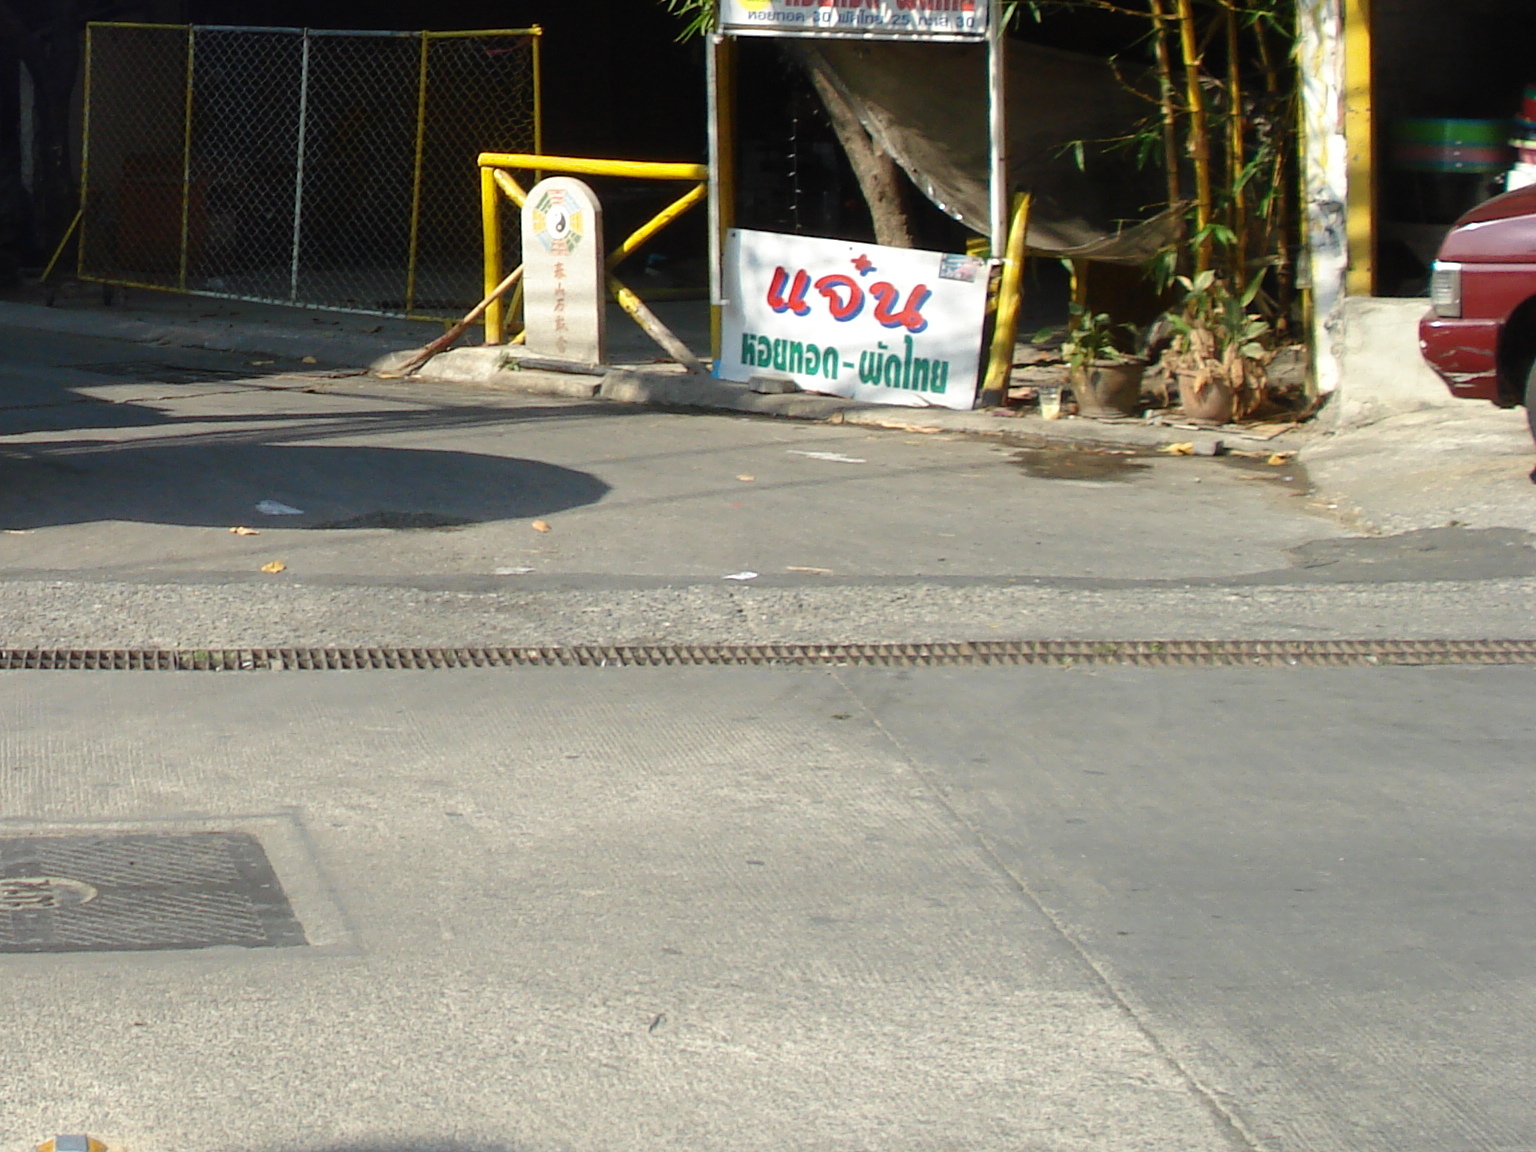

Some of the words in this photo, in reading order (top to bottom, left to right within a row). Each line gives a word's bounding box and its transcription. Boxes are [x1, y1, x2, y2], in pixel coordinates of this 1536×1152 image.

[813, 10, 832, 24] 30
[892, 13, 910, 26] 25
[956, 16, 975, 28] 30
[767, 253, 932, 334] แจ๋น
